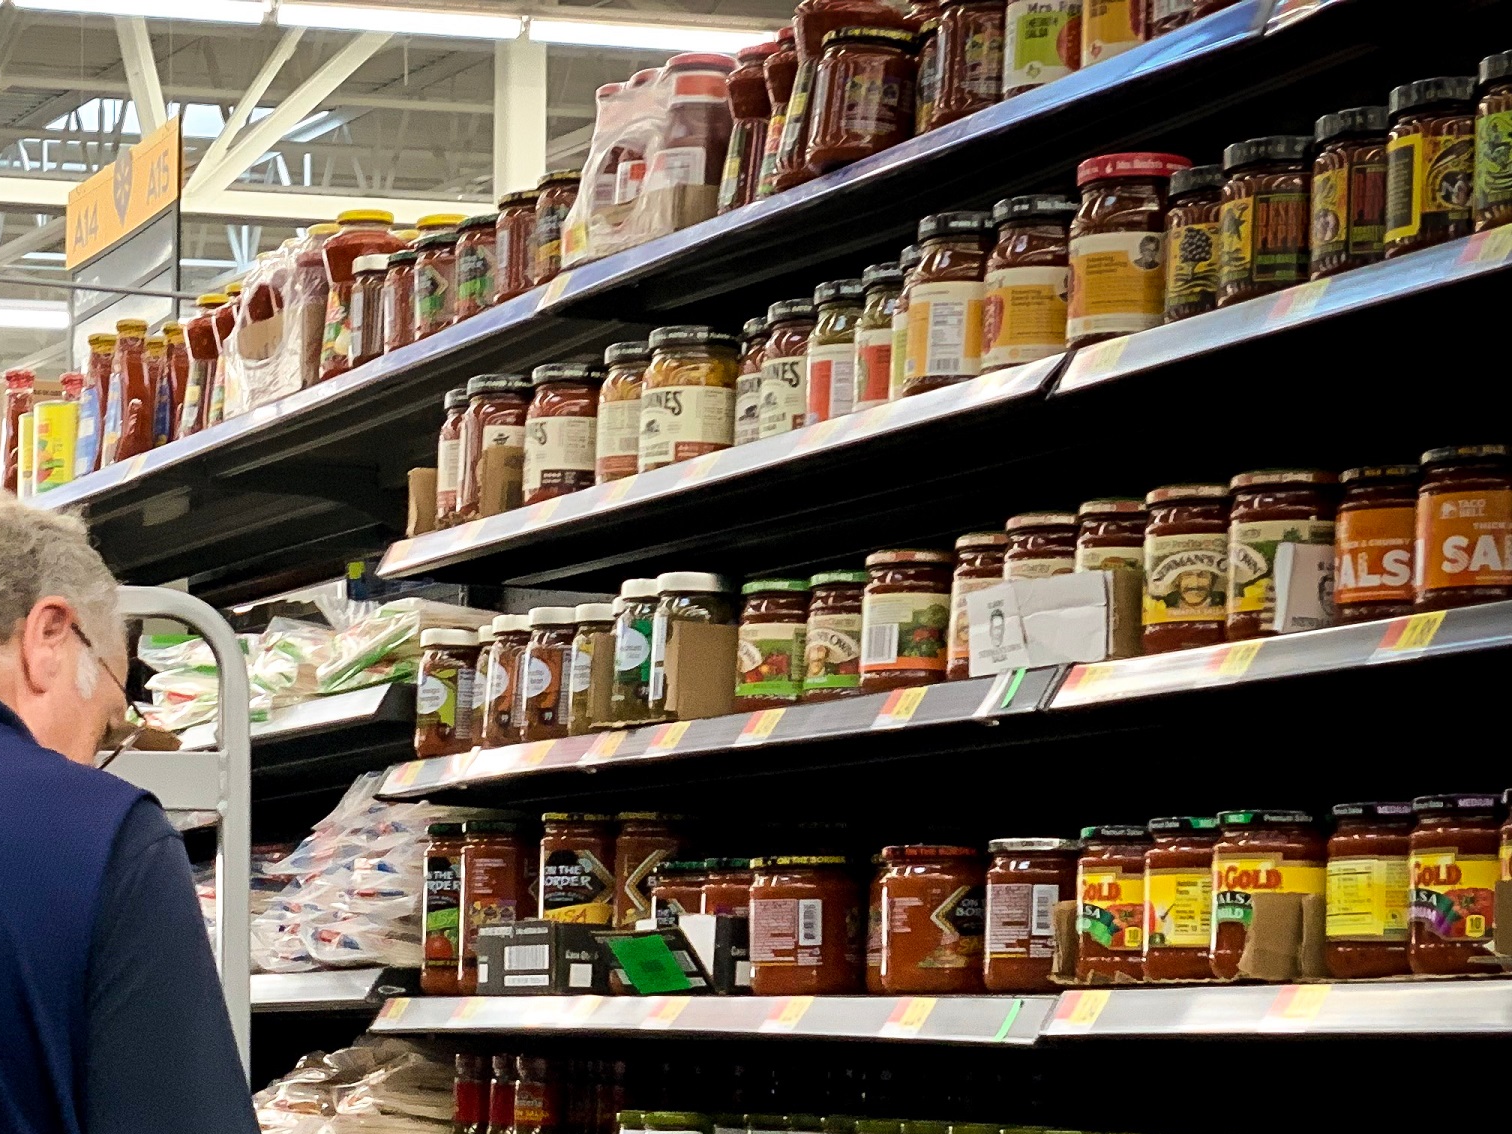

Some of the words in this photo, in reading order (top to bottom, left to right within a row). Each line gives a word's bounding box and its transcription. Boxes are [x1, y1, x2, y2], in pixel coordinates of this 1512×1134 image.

[146, 149, 170, 206] A15
[73, 200, 100, 254] A14
[1459, 499, 1486, 508] TACO
[1336, 549, 1411, 588] ALS
[558, 865, 581, 874] THE
[1226, 866, 1282, 889] GOLD
